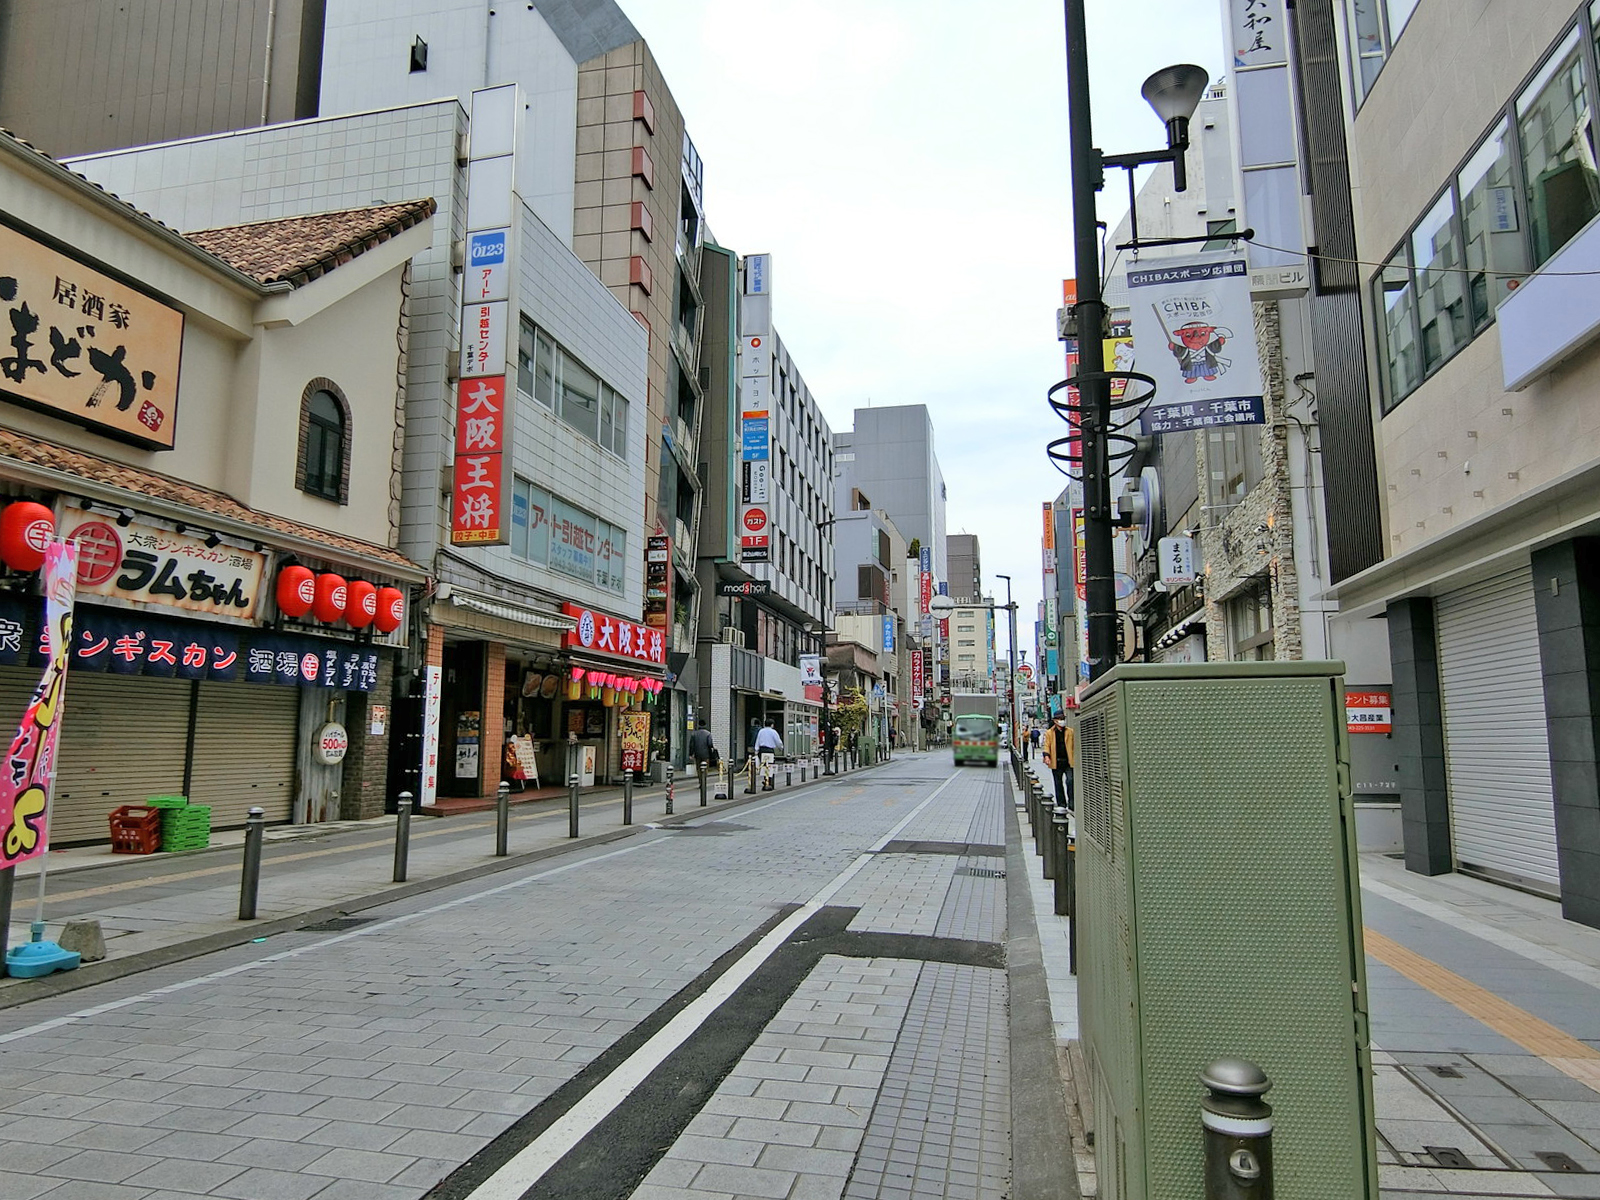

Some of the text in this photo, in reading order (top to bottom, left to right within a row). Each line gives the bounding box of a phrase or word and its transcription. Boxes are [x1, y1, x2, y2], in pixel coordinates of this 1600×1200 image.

[472, 243, 504, 258] 0123
[1132, 264, 1244, 284] CHIBAスポーツ応援団
[52, 275, 131, 330] 居酒家
[1164, 301, 1211, 312] CHIBA
[0, 300, 156, 412] まどか
[1153, 400, 1251, 420] 千葉県・千葉市
[460, 382, 500, 528] 大阪王将
[454, 530, 497, 541] 餃子・中華
[749, 537, 762, 546] 1F
[127, 532, 254, 571] 大衆ジンギスカン酒場
[1172, 542, 1183, 574] まるは
[116, 549, 250, 608] ラムちゃん
[598, 617, 662, 662] 大阪王将
[249, 648, 299, 676] 酒場
